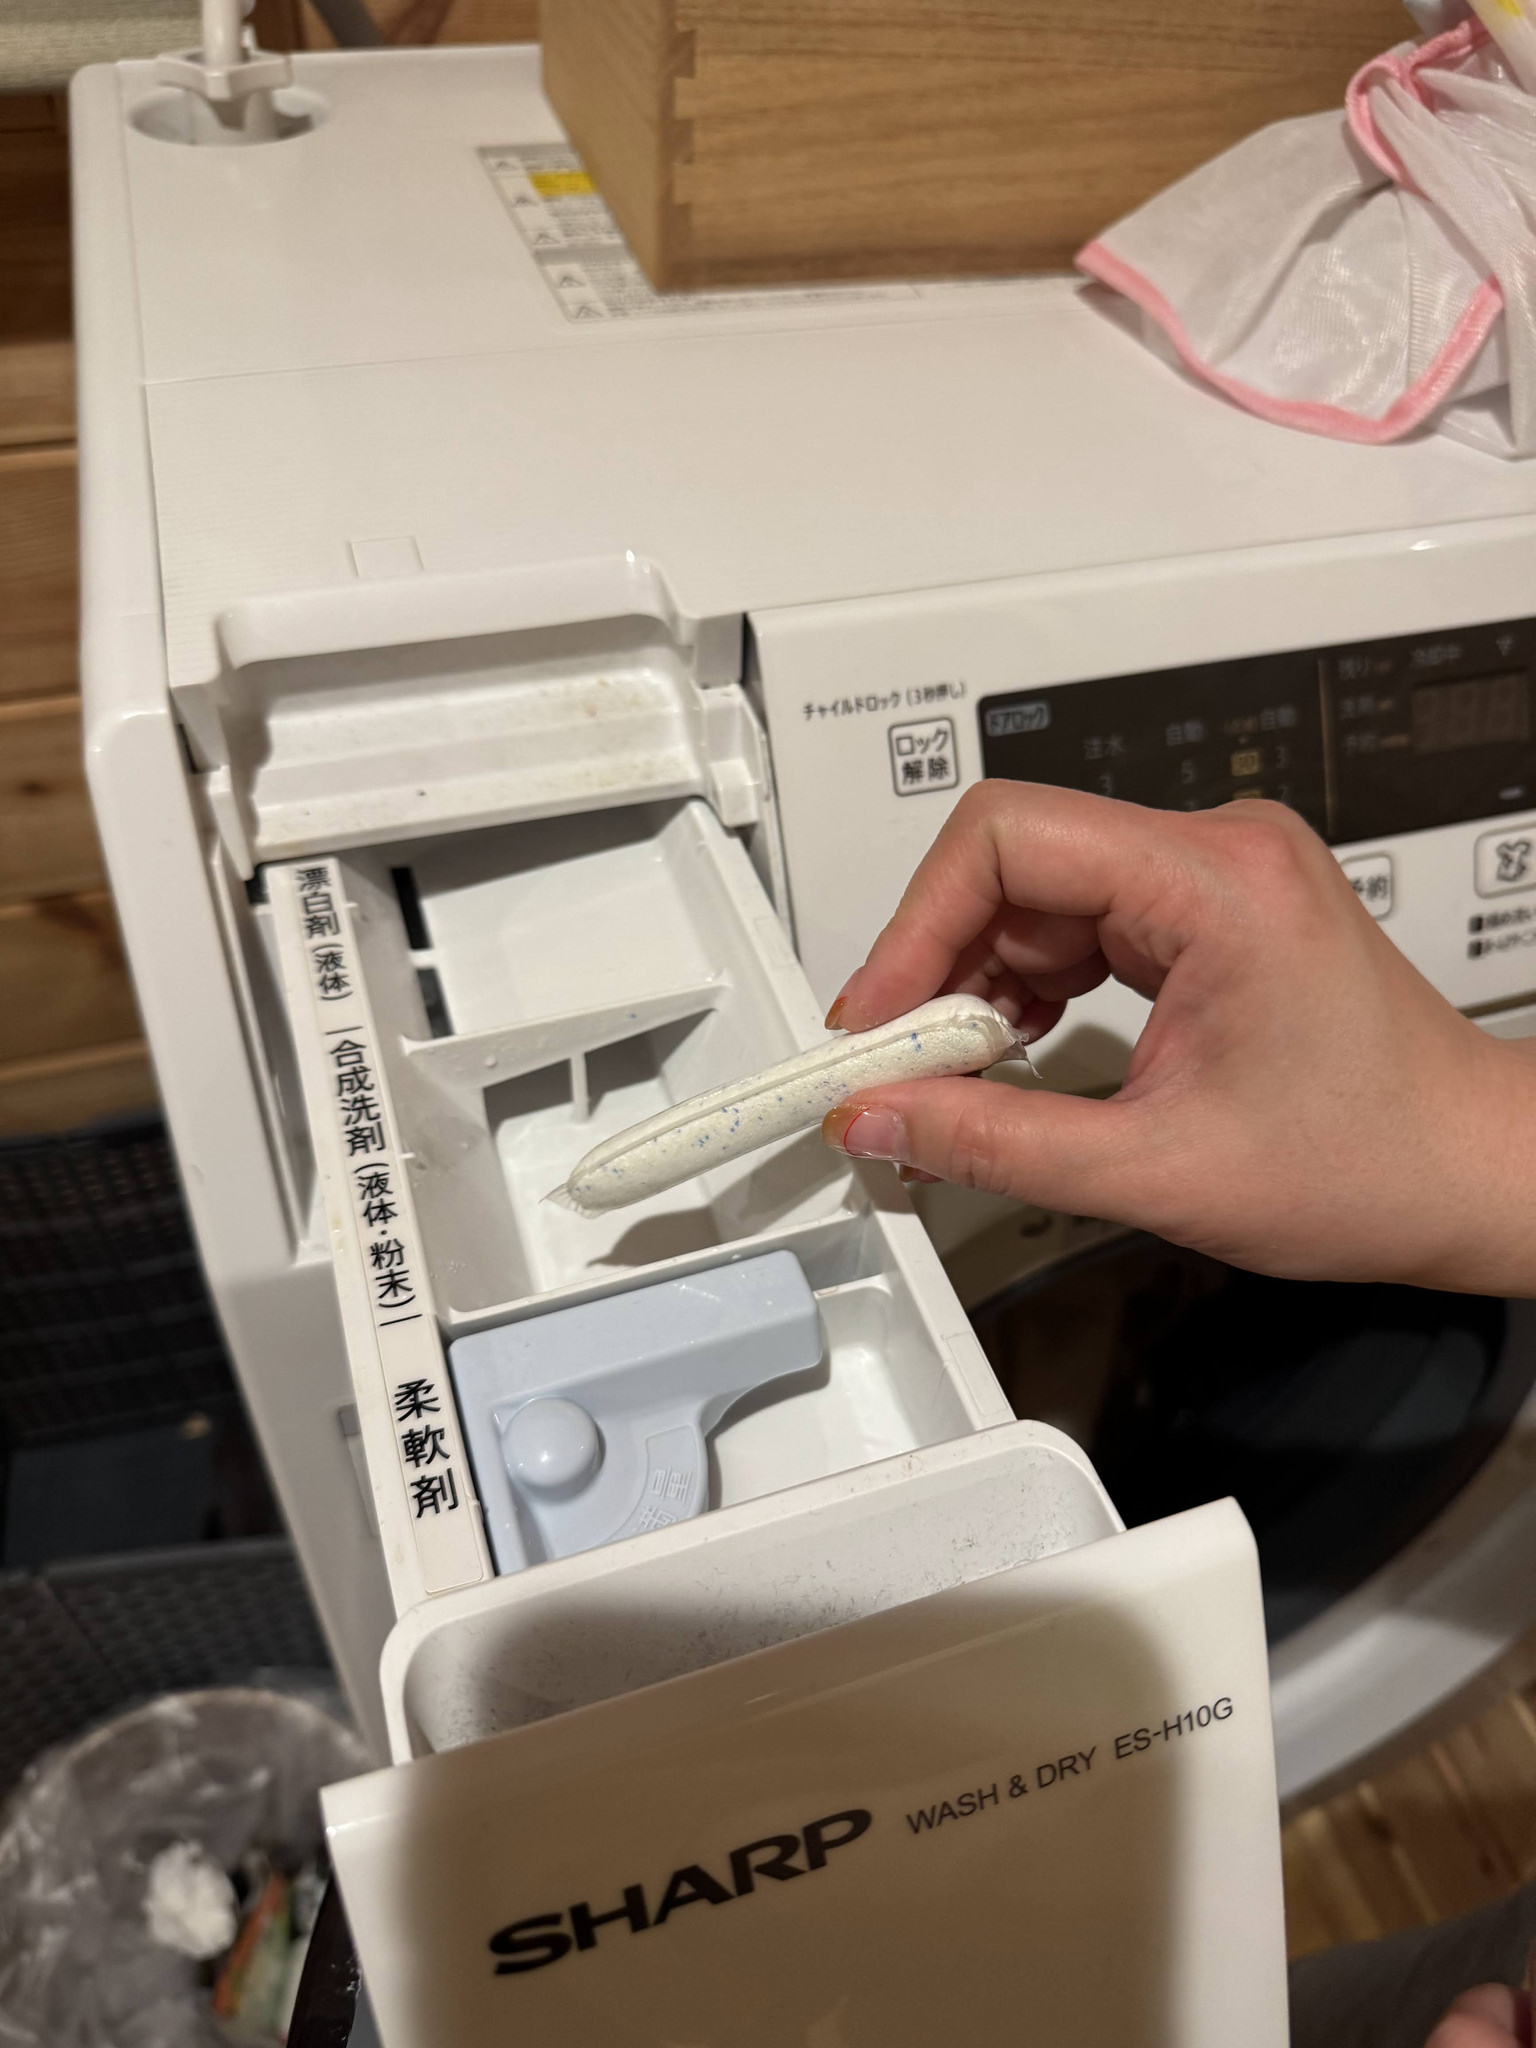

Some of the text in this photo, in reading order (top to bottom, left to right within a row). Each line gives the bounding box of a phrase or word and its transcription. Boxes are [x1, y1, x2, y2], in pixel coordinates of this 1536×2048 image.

[896, 728, 949, 757] ロック
[902, 757, 951, 785] 解除
[395, 1378, 459, 1519] 柔軟剤
[906, 1697, 1234, 1834] WASH & DRY ES-H10G
[487, 1808, 873, 1977] SHARP
